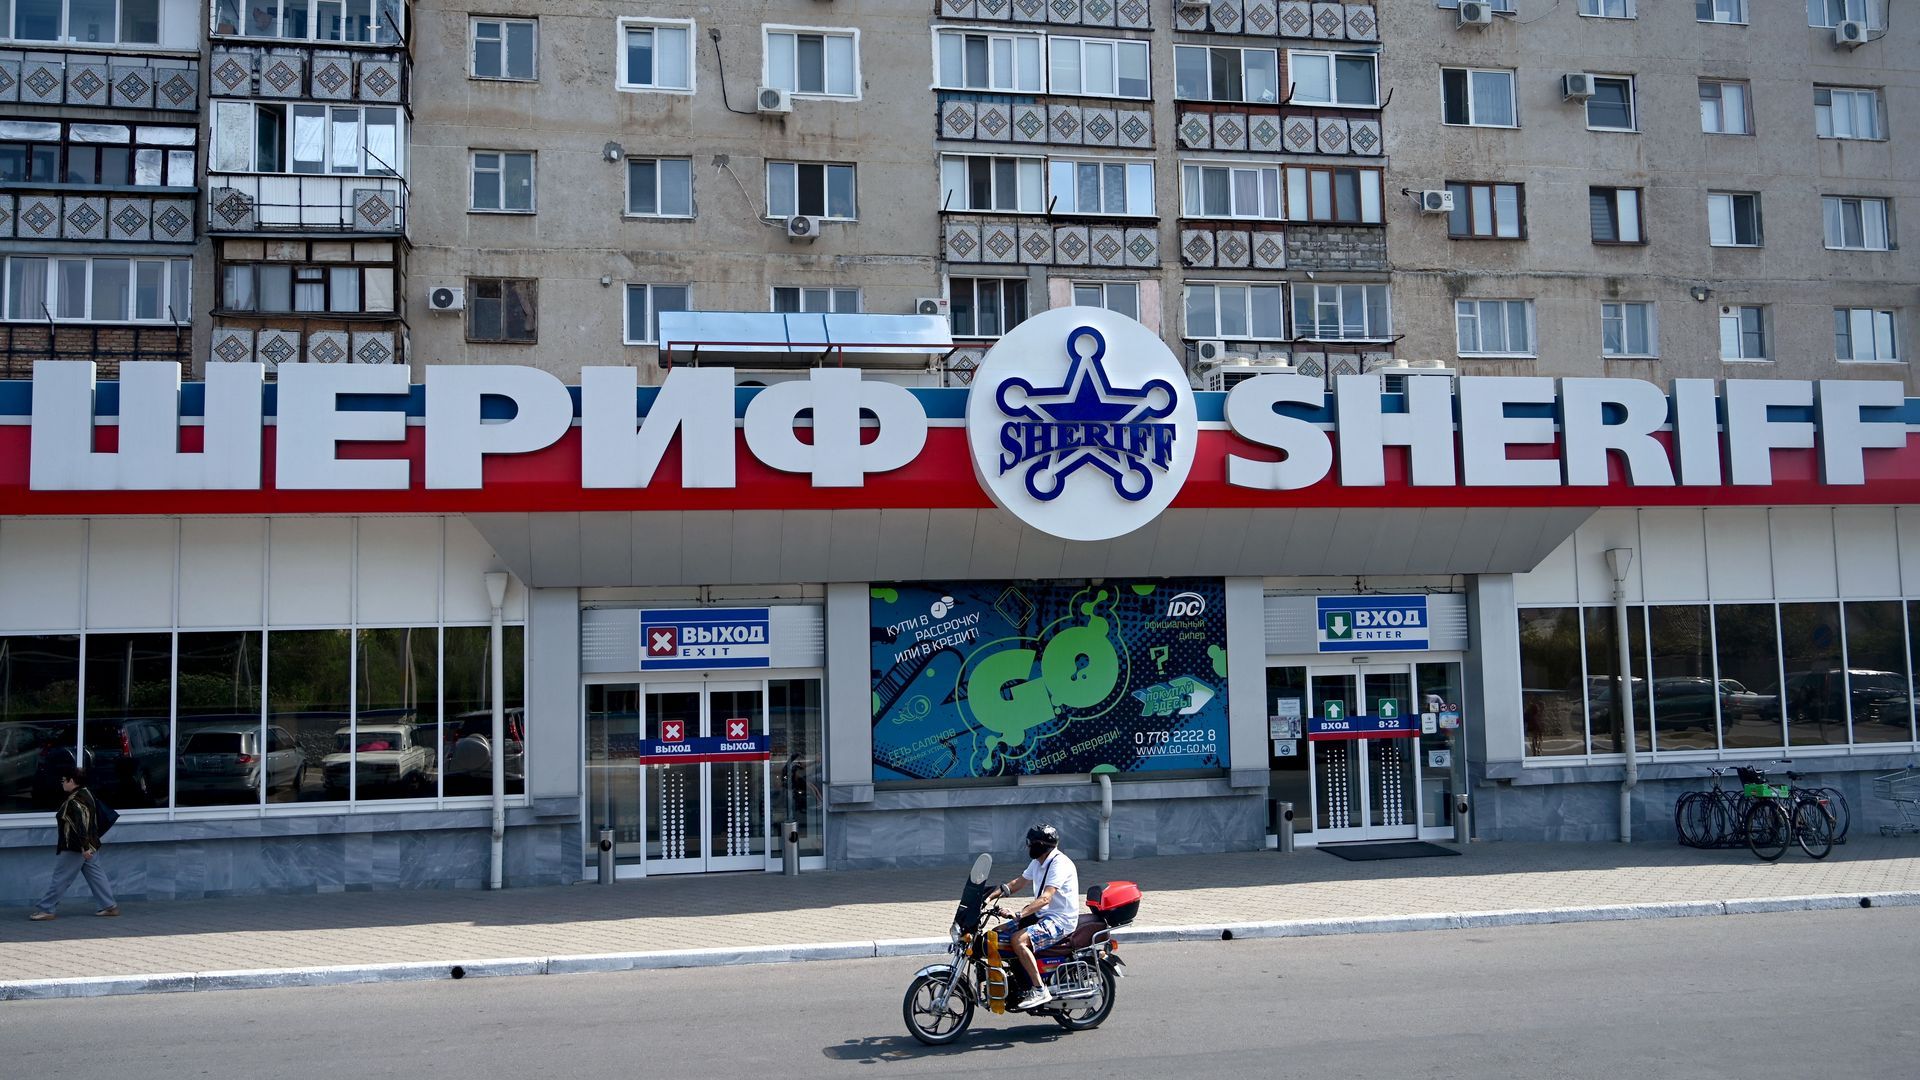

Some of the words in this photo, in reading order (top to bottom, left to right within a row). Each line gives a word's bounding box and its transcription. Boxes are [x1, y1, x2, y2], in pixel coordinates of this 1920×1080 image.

[29, 360, 928, 491] ШЕРИФ
[1225, 373, 1906, 490] SHERIFF
[999, 421, 1177, 478] SHERIFF
[1167, 599, 1201, 617] IDC
[886, 617, 919, 637] КУПИ
[919, 614, 929, 626] В
[915, 611, 980, 642] РАССРОЧКУ
[1144, 620, 1205, 631] официальный
[1355, 609, 1421, 627] ВХОД
[682, 625, 765, 644] ВЫХОД
[1356, 630, 1402, 640] ENTER
[682, 647, 730, 657] EXIT
[894, 646, 920, 664] ИЛИ
[921, 643, 931, 655] В
[931, 627, 981, 651] КРЕДИТ!
[1146, 680, 1195, 702] ПОКУПАЙ
[1320, 721, 1350, 730] ВХОД
[889, 745, 912, 761] СЕТЬ
[911, 728, 957, 751] САЛОНОВ
[1146, 731, 1170, 744] 778
[1173, 730, 1204, 743] 2222
[1207, 729, 1216, 741] 8
[655, 744, 692, 754] ВЫХОД
[720, 742, 756, 752] ВЫХОД
[1026, 750, 1068, 772] Всегда
[1070, 726, 1122, 755] впереди!
[1136, 744, 1217, 756] WWW.GO-GO.MD
